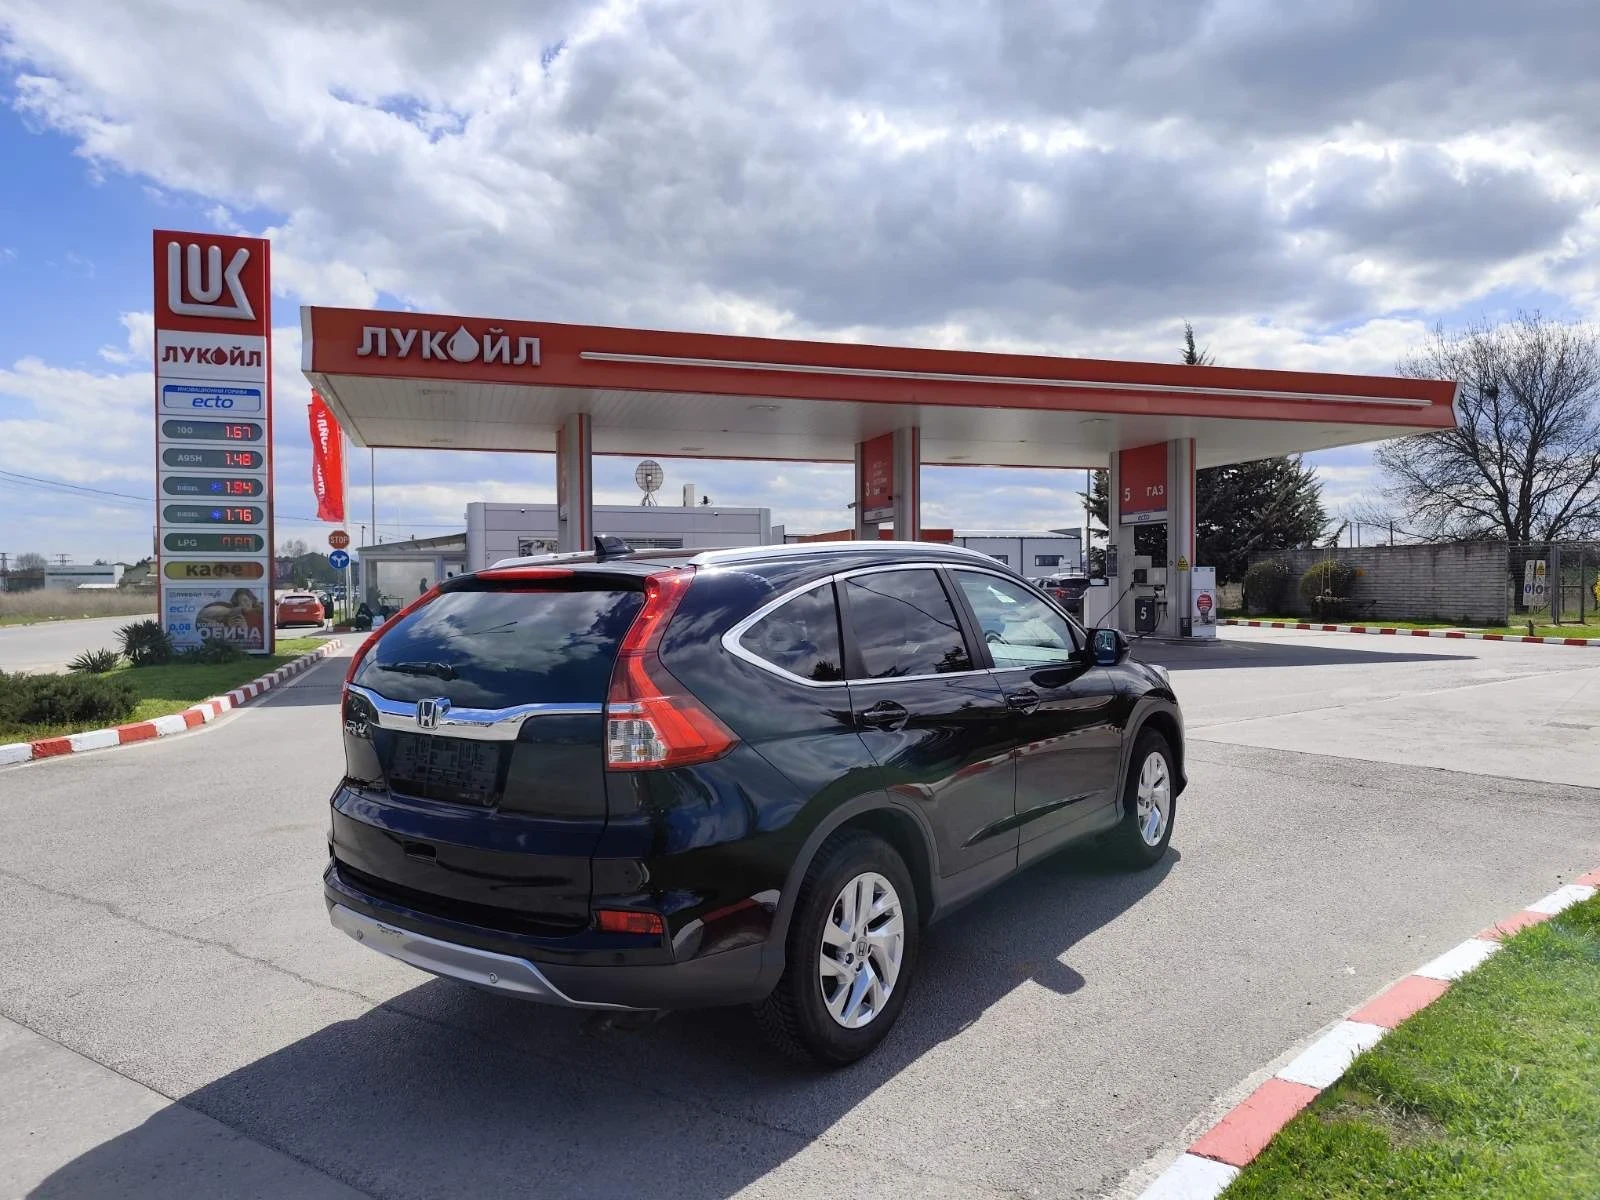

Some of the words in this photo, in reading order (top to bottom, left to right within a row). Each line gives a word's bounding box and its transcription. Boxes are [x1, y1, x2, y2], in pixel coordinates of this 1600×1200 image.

[356, 324, 541, 367] ЛУКОЙЛ
[161, 345, 262, 367] ЛУКОЙЛ
[192, 395, 234, 409] ecto
[177, 426, 193, 434] 100
[225, 425, 251, 438] 1.67
[225, 453, 252, 466] 1.48
[1124, 487, 1131, 502] 5
[1146, 484, 1164, 497] ГАЗ
[225, 509, 252, 522] 1.76
[177, 539, 198, 547] LPG
[330, 535, 349, 545] STOP
[186, 563, 242, 577] кафе
[1140, 607, 1147, 620] 5
[198, 627, 262, 640] ОБИЧА
